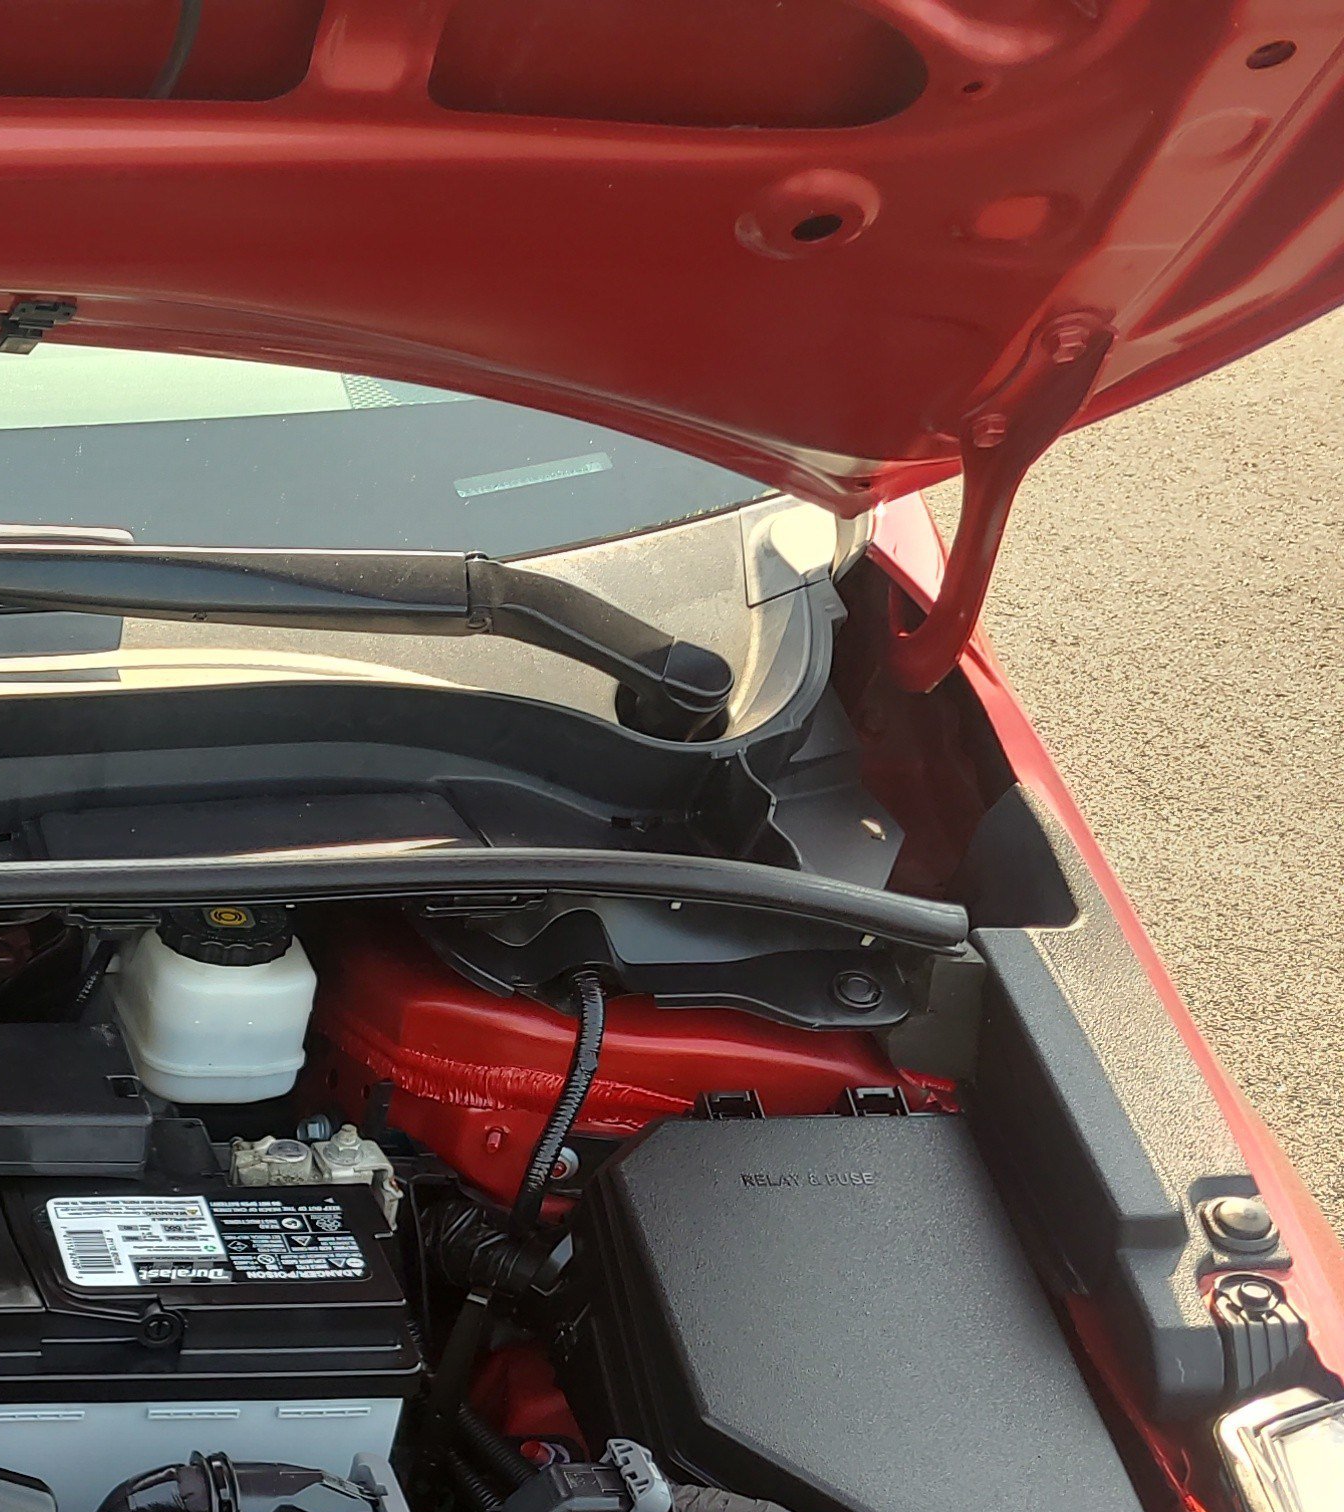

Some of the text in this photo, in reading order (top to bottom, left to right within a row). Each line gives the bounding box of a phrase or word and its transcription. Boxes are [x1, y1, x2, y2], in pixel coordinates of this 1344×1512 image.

[740, 1172, 875, 1187] RELAY & FUSE
[138, 1268, 229, 1280] Duralast
